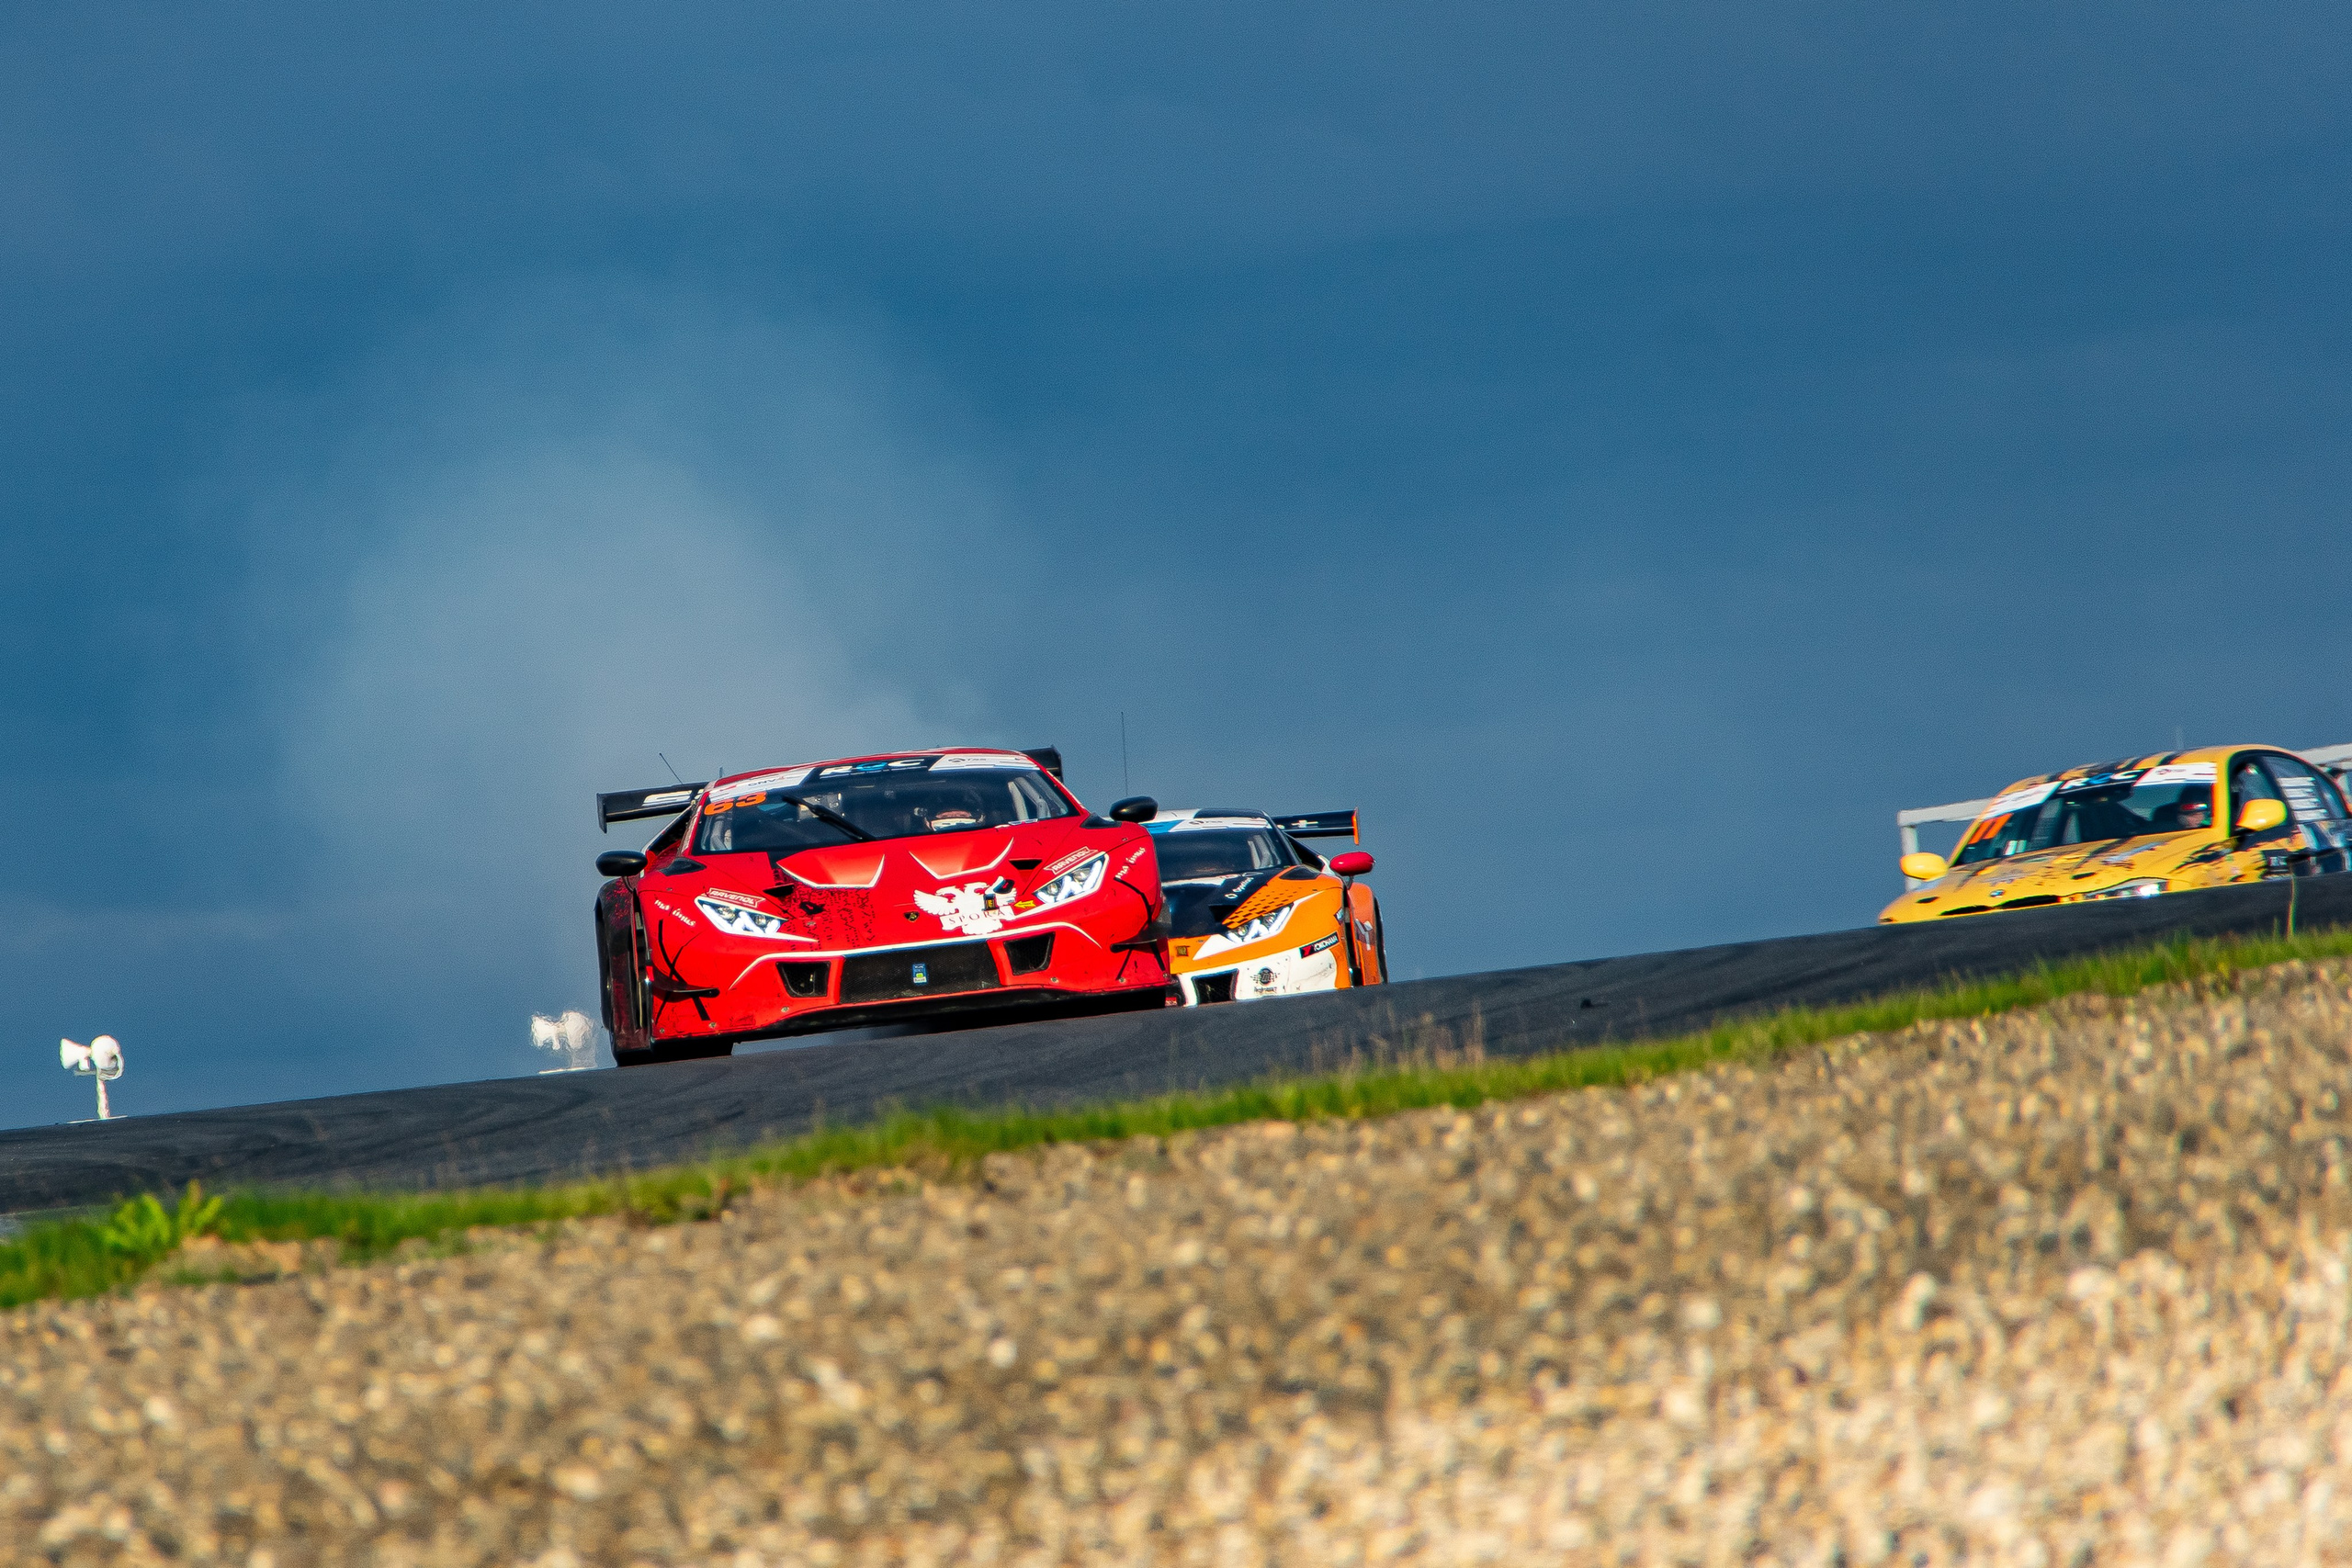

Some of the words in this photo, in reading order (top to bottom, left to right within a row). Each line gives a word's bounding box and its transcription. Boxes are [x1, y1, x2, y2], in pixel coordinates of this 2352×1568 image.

[704, 791, 767, 816] 63
[1051, 847, 1091, 872] RAVENOL
[709, 888, 759, 906] RAVENOL
[948, 908, 1006, 925] SPORA
